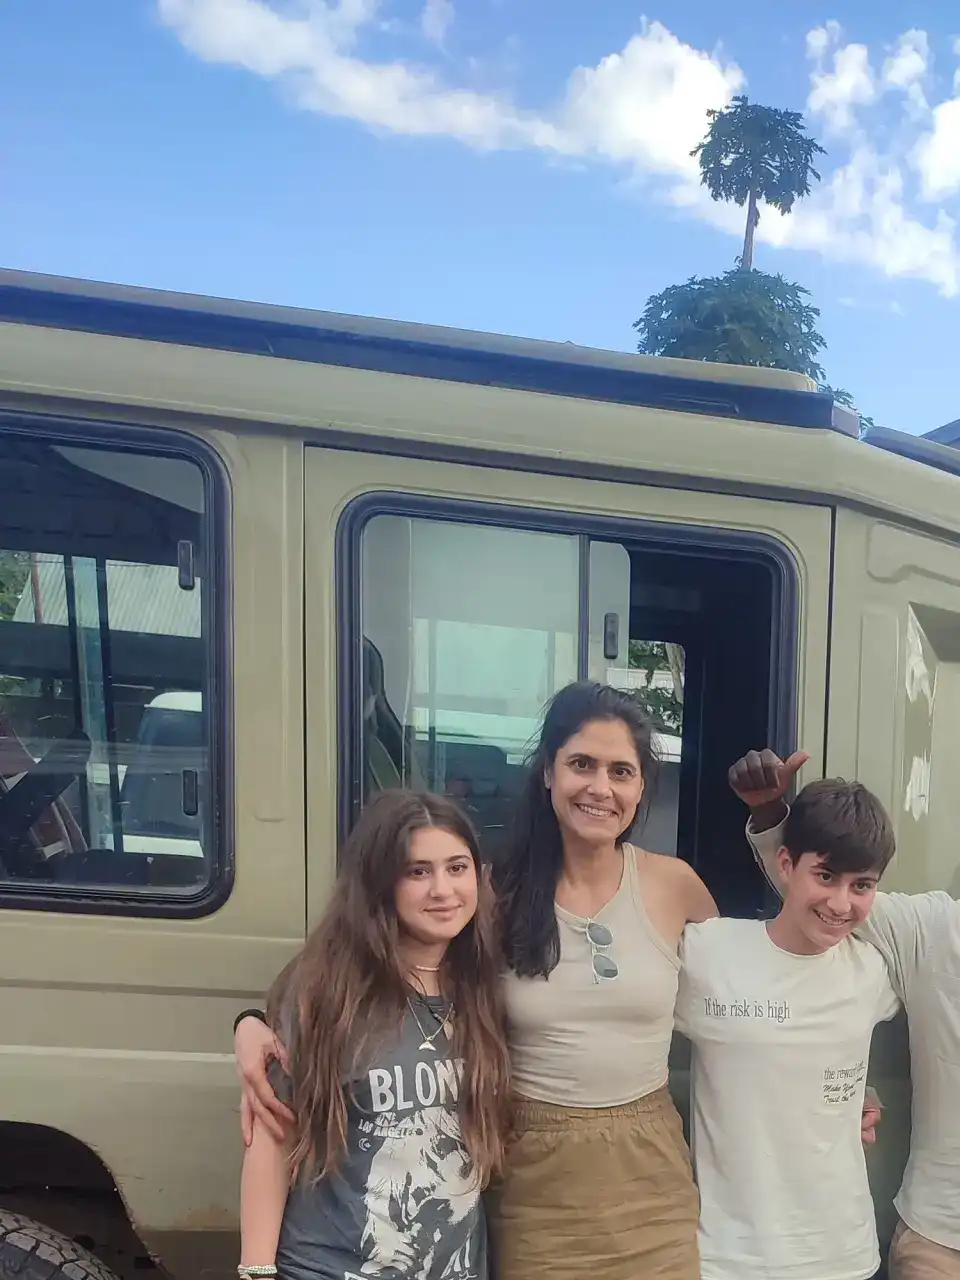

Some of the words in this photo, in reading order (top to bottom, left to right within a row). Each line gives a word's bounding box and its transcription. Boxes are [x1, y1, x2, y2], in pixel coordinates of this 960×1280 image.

[704, 998, 711, 1016] If
[712, 998, 727, 1017] the
[730, 999, 750, 1017] risk
[753, 1000, 763, 1018] is
[766, 1000, 790, 1024] high
[358, 1118, 374, 1134] LOS
